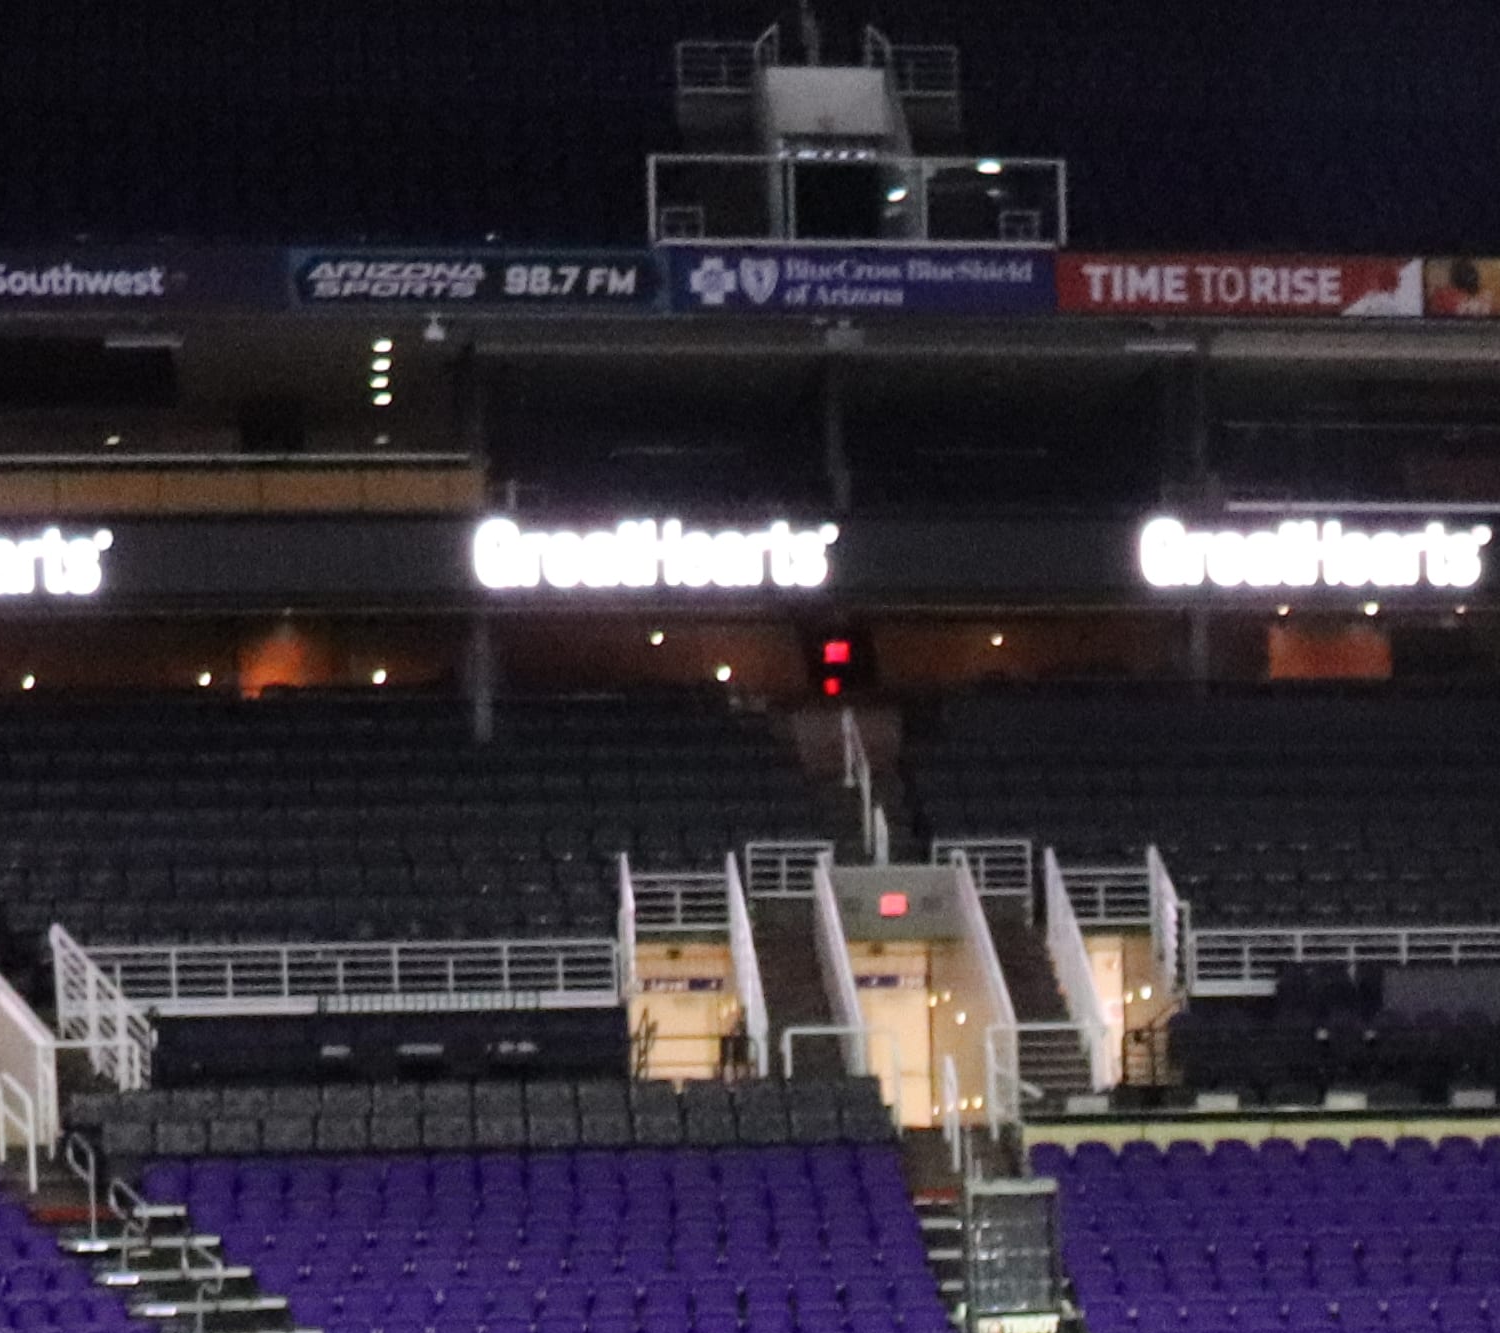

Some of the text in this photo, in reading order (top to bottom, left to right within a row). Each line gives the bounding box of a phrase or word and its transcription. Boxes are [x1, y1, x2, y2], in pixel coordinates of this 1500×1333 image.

[307, 262, 486, 280] ARIZONA
[585, 266, 637, 296] FM
[312, 279, 477, 297] SPORTS
[1082, 264, 1342, 306] TIME TO RISE
